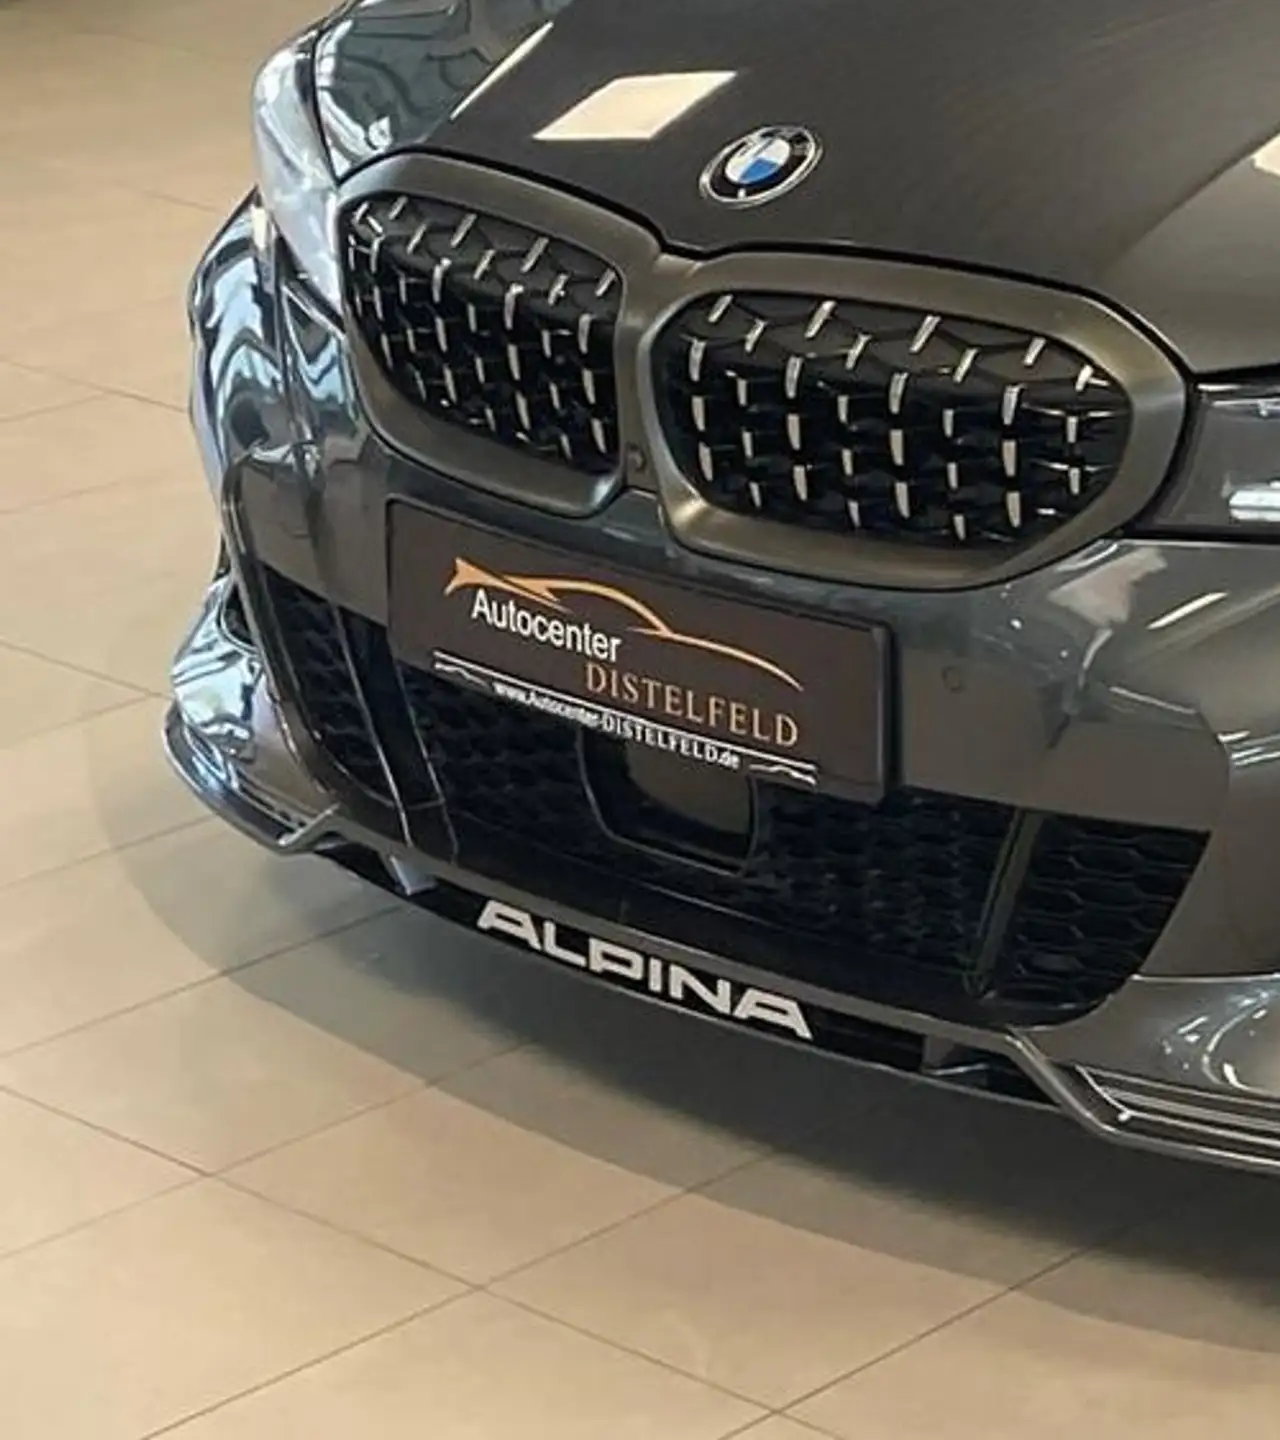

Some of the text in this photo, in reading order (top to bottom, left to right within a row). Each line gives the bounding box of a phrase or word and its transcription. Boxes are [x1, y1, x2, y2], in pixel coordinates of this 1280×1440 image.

[471, 589, 622, 662] Autocenter
[585, 664, 799, 748] DISTELFELD
[476, 898, 813, 1041] ALPINA
